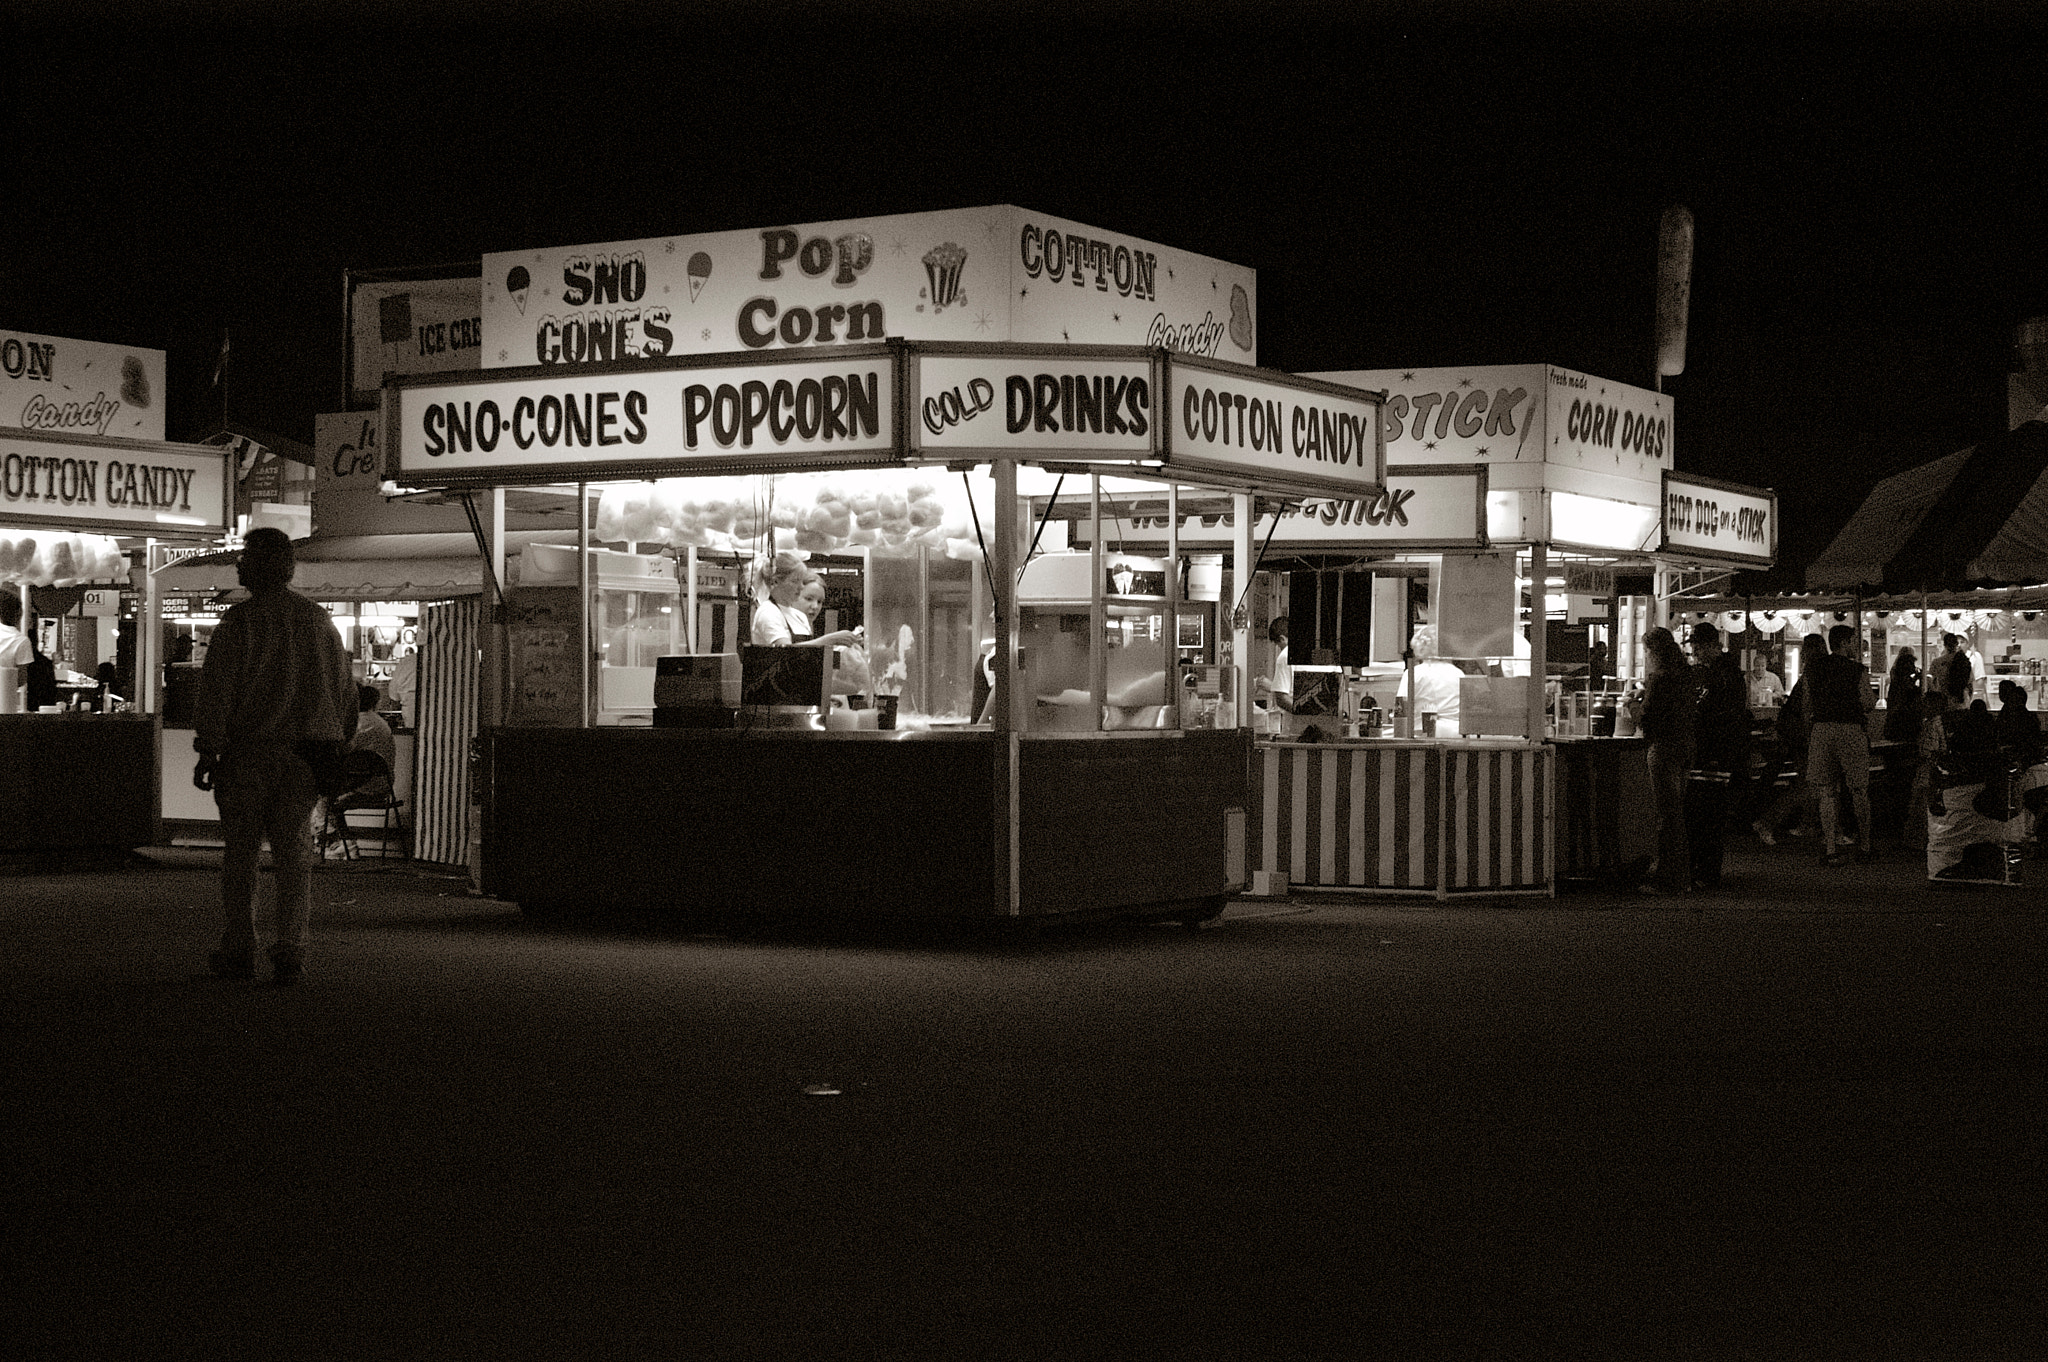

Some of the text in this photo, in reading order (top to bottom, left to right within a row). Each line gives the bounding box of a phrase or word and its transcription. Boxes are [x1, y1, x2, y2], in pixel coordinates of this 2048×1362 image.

[562, 250, 647, 306] SNO
[757, 225, 876, 288] Pop
[1019, 222, 1157, 301] COTTON
[418, 322, 446, 356] ICE
[536, 305, 674, 365] CONES
[735, 294, 887, 349] Corn
[1146, 310, 1225, 358] Candy
[922, 373, 1150, 437] COLD DRINKS
[1549, 367, 1567, 387] fresh
[21, 390, 121, 436] Candy
[682, 371, 880, 451] POPCORN
[1182, 384, 1368, 468] COTTON CANDY
[1386, 386, 1528, 443] STICK
[1567, 396, 1665, 459] CORN DOGS
[0, 452, 197, 512] OTTON CANDY
[1319, 488, 1416, 526] STICK
[1668, 492, 1693, 533] HOT
[1695, 498, 1719, 538] DOG
[1736, 505, 1767, 545] STICK
